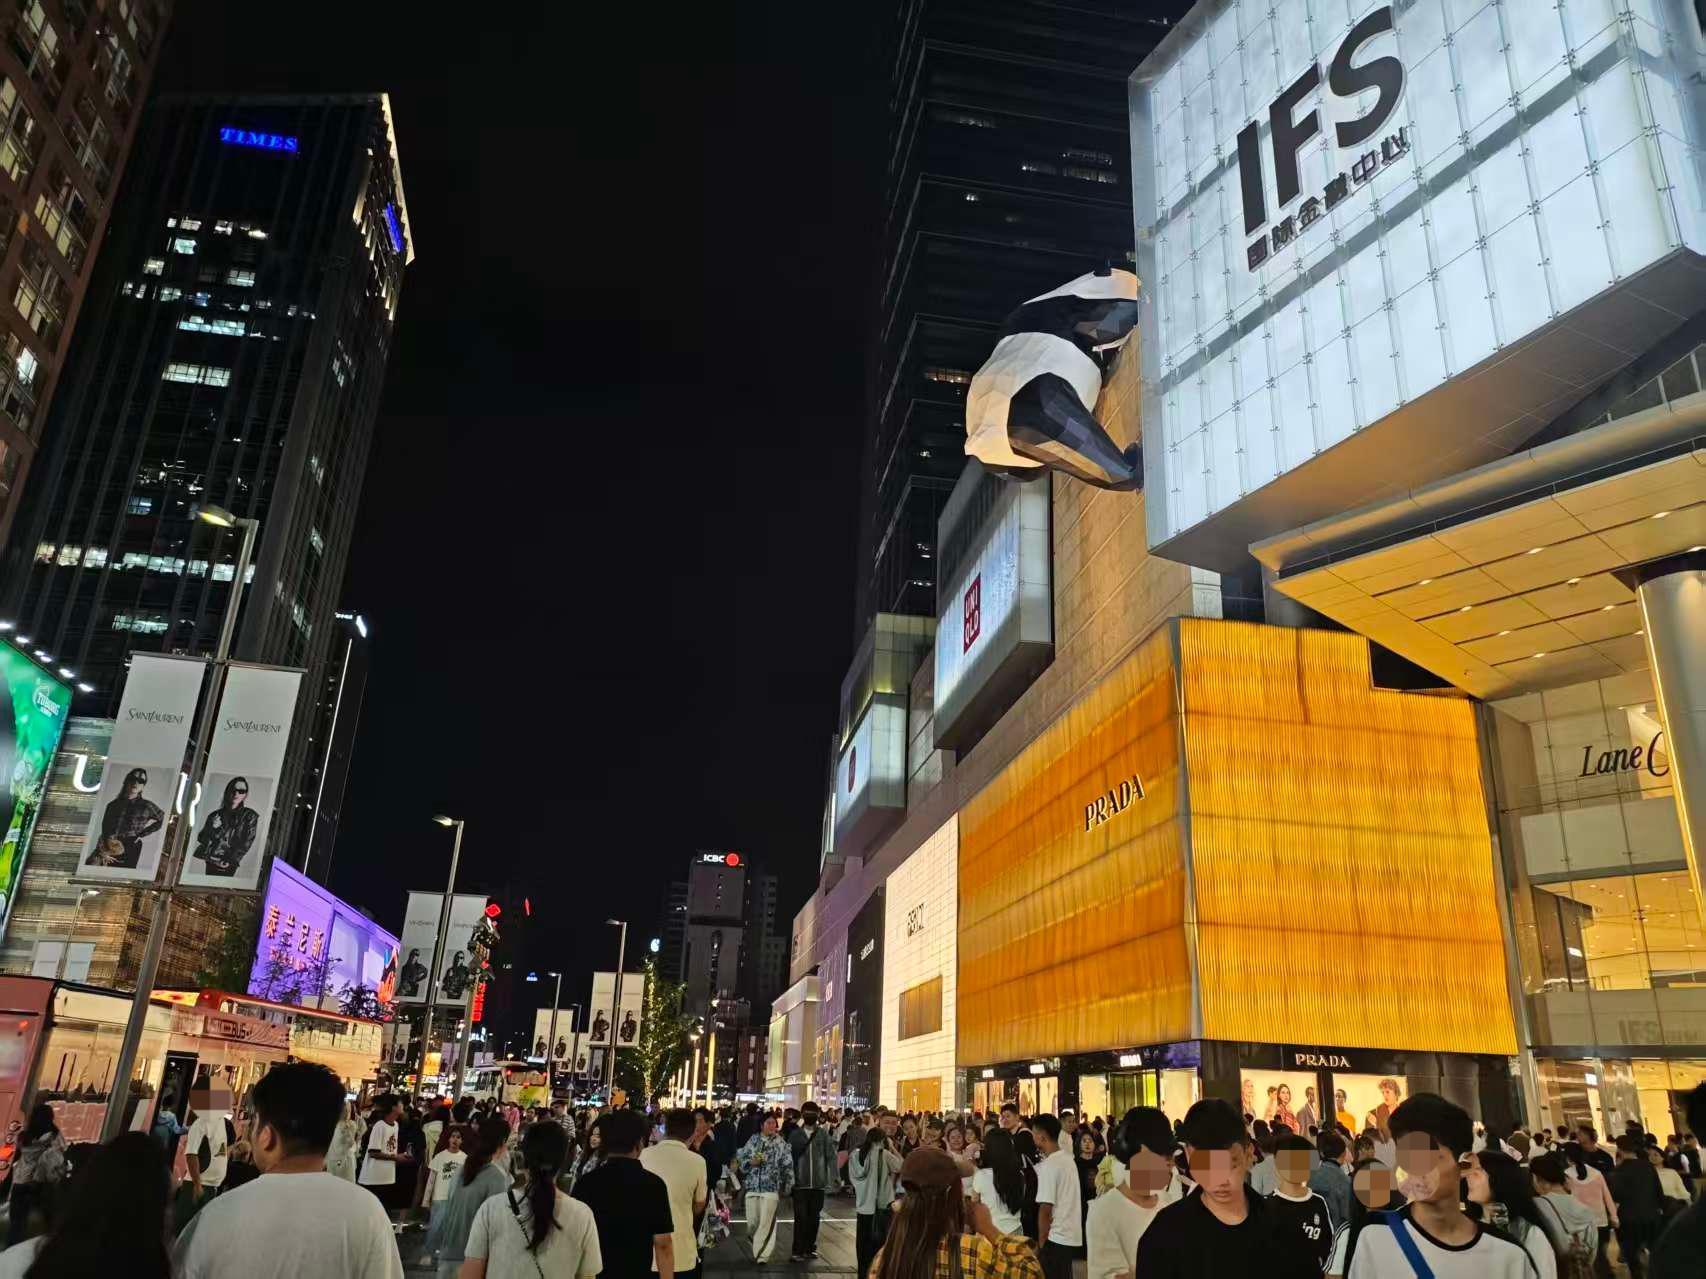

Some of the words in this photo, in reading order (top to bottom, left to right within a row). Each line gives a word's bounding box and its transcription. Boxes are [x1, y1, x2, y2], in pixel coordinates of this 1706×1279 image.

[1237, 5, 1408, 237] IFS
[220, 126, 298, 152] TIMES
[965, 584, 978, 619] UNI
[1578, 745, 1643, 778] Lane
[1084, 774, 1145, 832] PRADA
[703, 853, 725, 863] ICBC
[1295, 1053, 1352, 1069] PRADA
